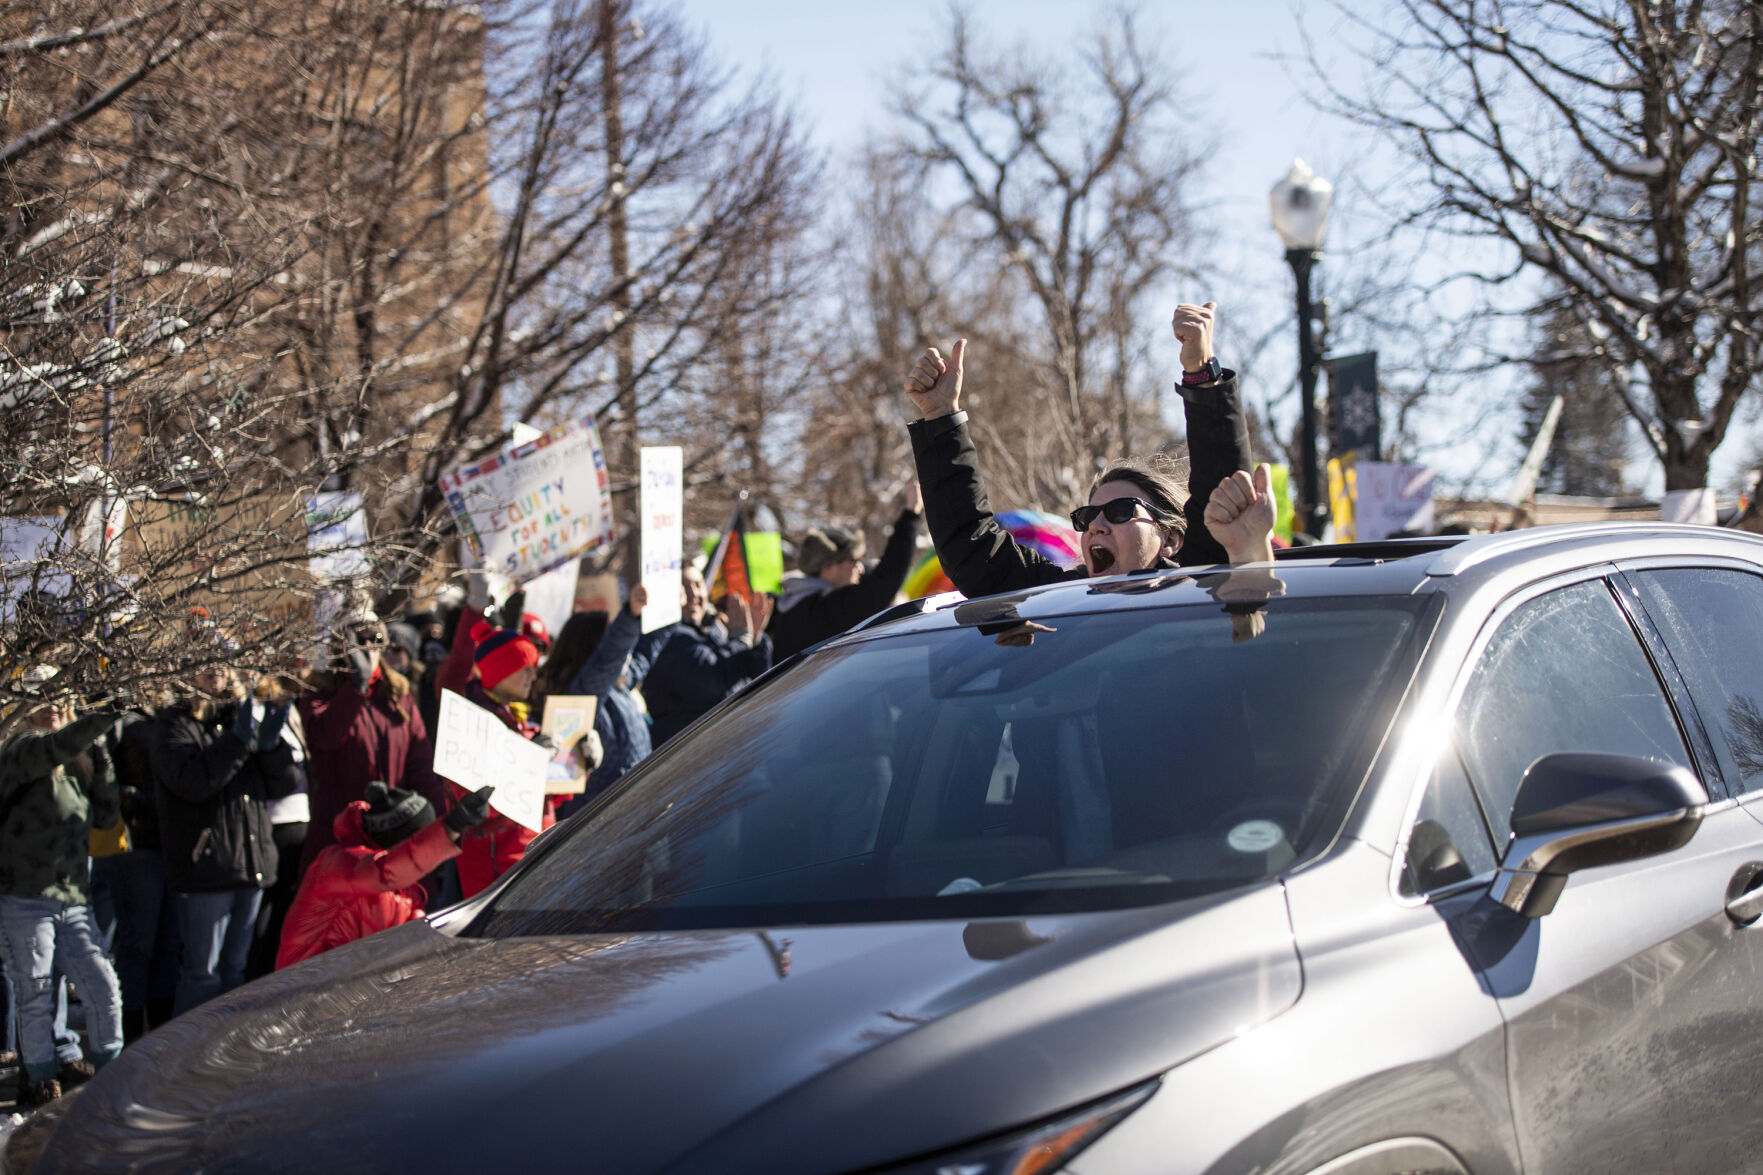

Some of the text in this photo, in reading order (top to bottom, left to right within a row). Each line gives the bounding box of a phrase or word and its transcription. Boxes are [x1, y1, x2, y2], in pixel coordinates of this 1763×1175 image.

[490, 477, 564, 530] EQUITY
[511, 503, 571, 547] FOR ALL
[447, 697, 517, 765] ETHCS
[445, 740, 533, 816] POLCS
